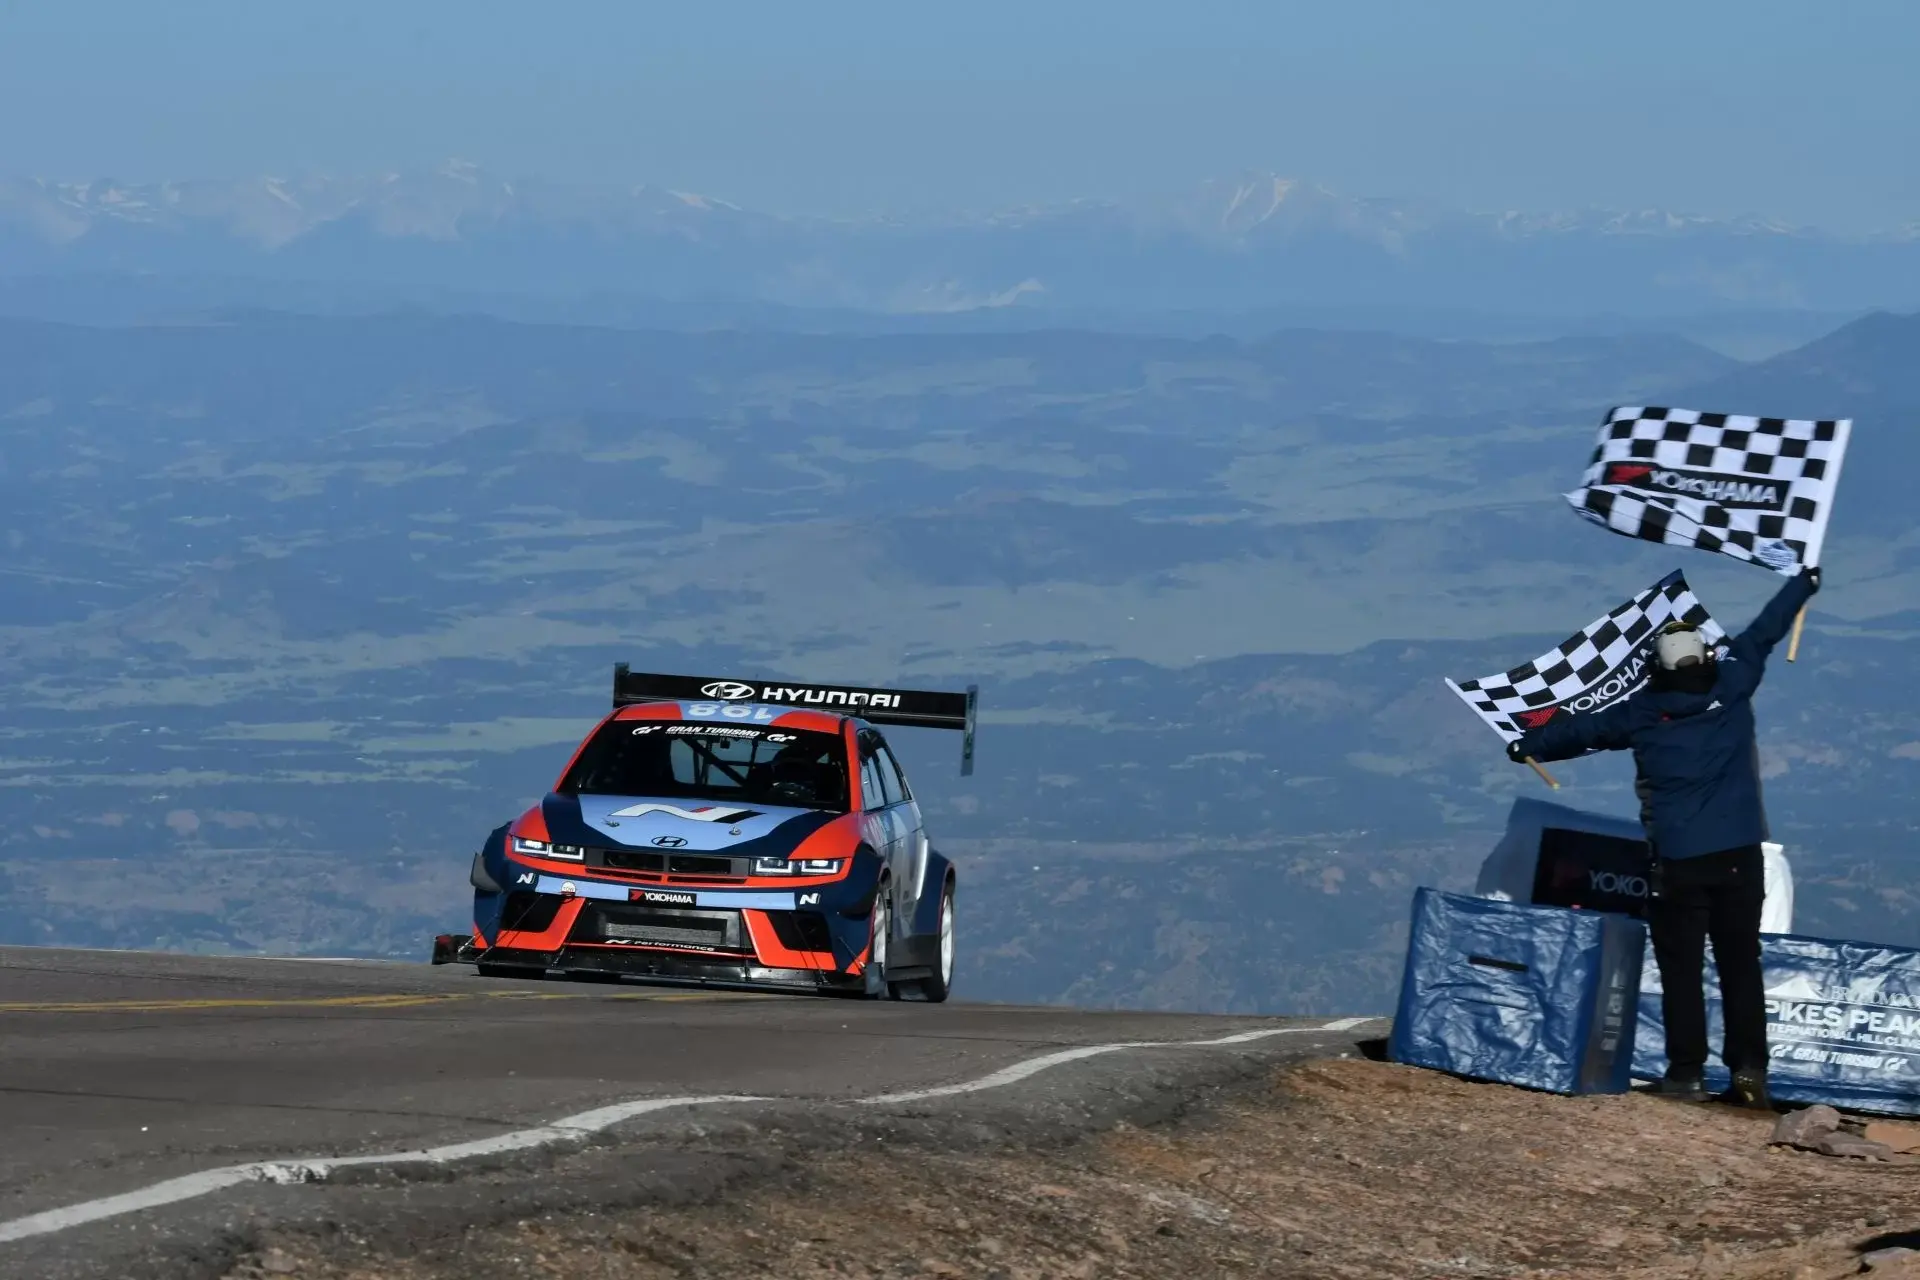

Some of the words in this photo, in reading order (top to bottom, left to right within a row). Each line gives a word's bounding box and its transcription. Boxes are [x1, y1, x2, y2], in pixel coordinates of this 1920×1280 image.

[1649, 469, 1777, 504] YOKOHAMA
[762, 687, 901, 708] HYUNDAI
[666, 725, 704, 734] GRAN
[704, 726, 761, 738] TURISMO
[1589, 869, 1648, 898] YOKO
[644, 892, 693, 904] YOKOHAMA
[634, 940, 715, 952] Performance
[1765, 999, 1843, 1027] PIKES
[1848, 1009, 1920, 1036] PEAK
[1793, 1047, 1830, 1063] GRAN
[1829, 1051, 1883, 1069] TURISMO
